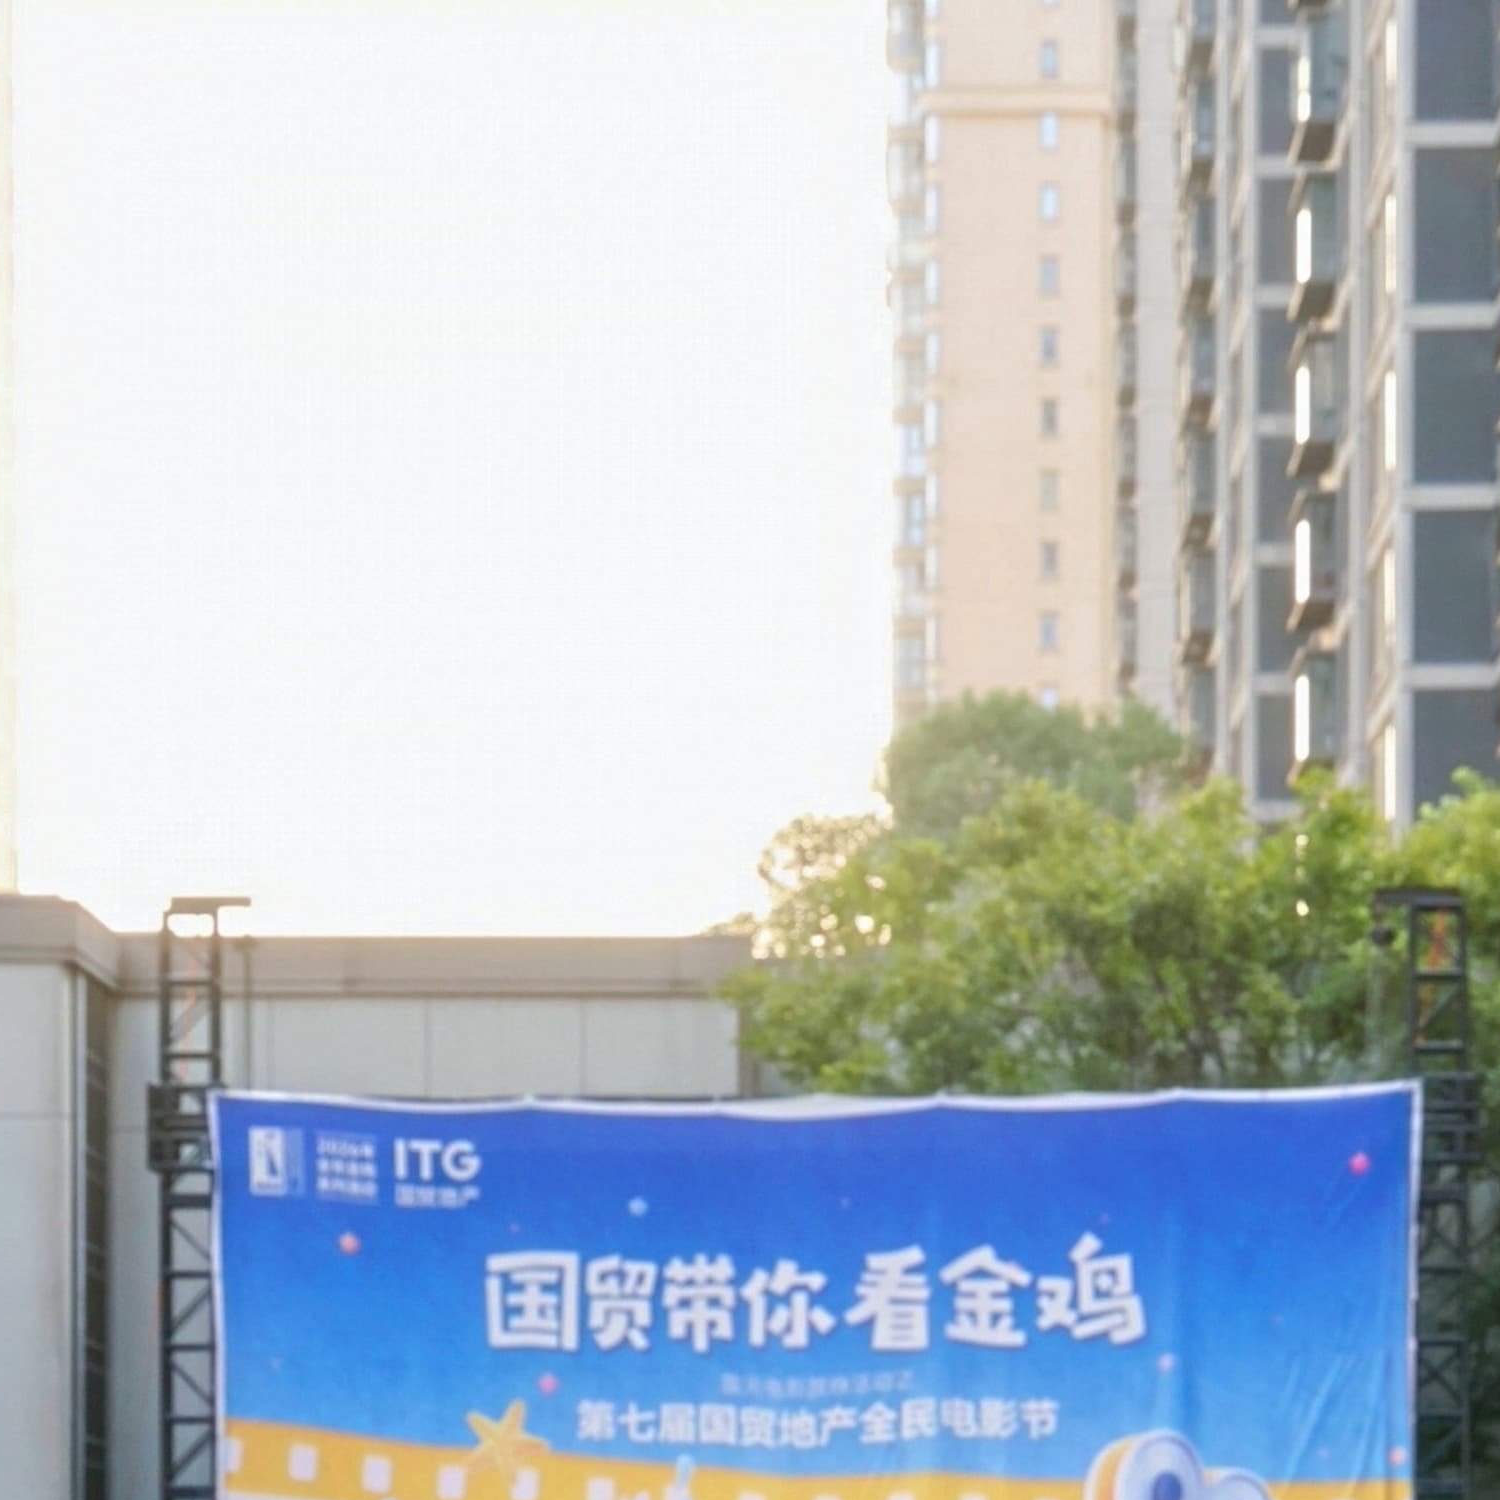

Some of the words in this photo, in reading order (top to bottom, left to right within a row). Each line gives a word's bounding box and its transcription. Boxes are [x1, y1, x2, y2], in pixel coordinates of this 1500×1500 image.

[394, 1138, 481, 1182] ITG
[485, 1231, 1147, 1352] 国贸带你看金鸡
[576, 1397, 1060, 1450] 第七届国贸地产全民电影节
